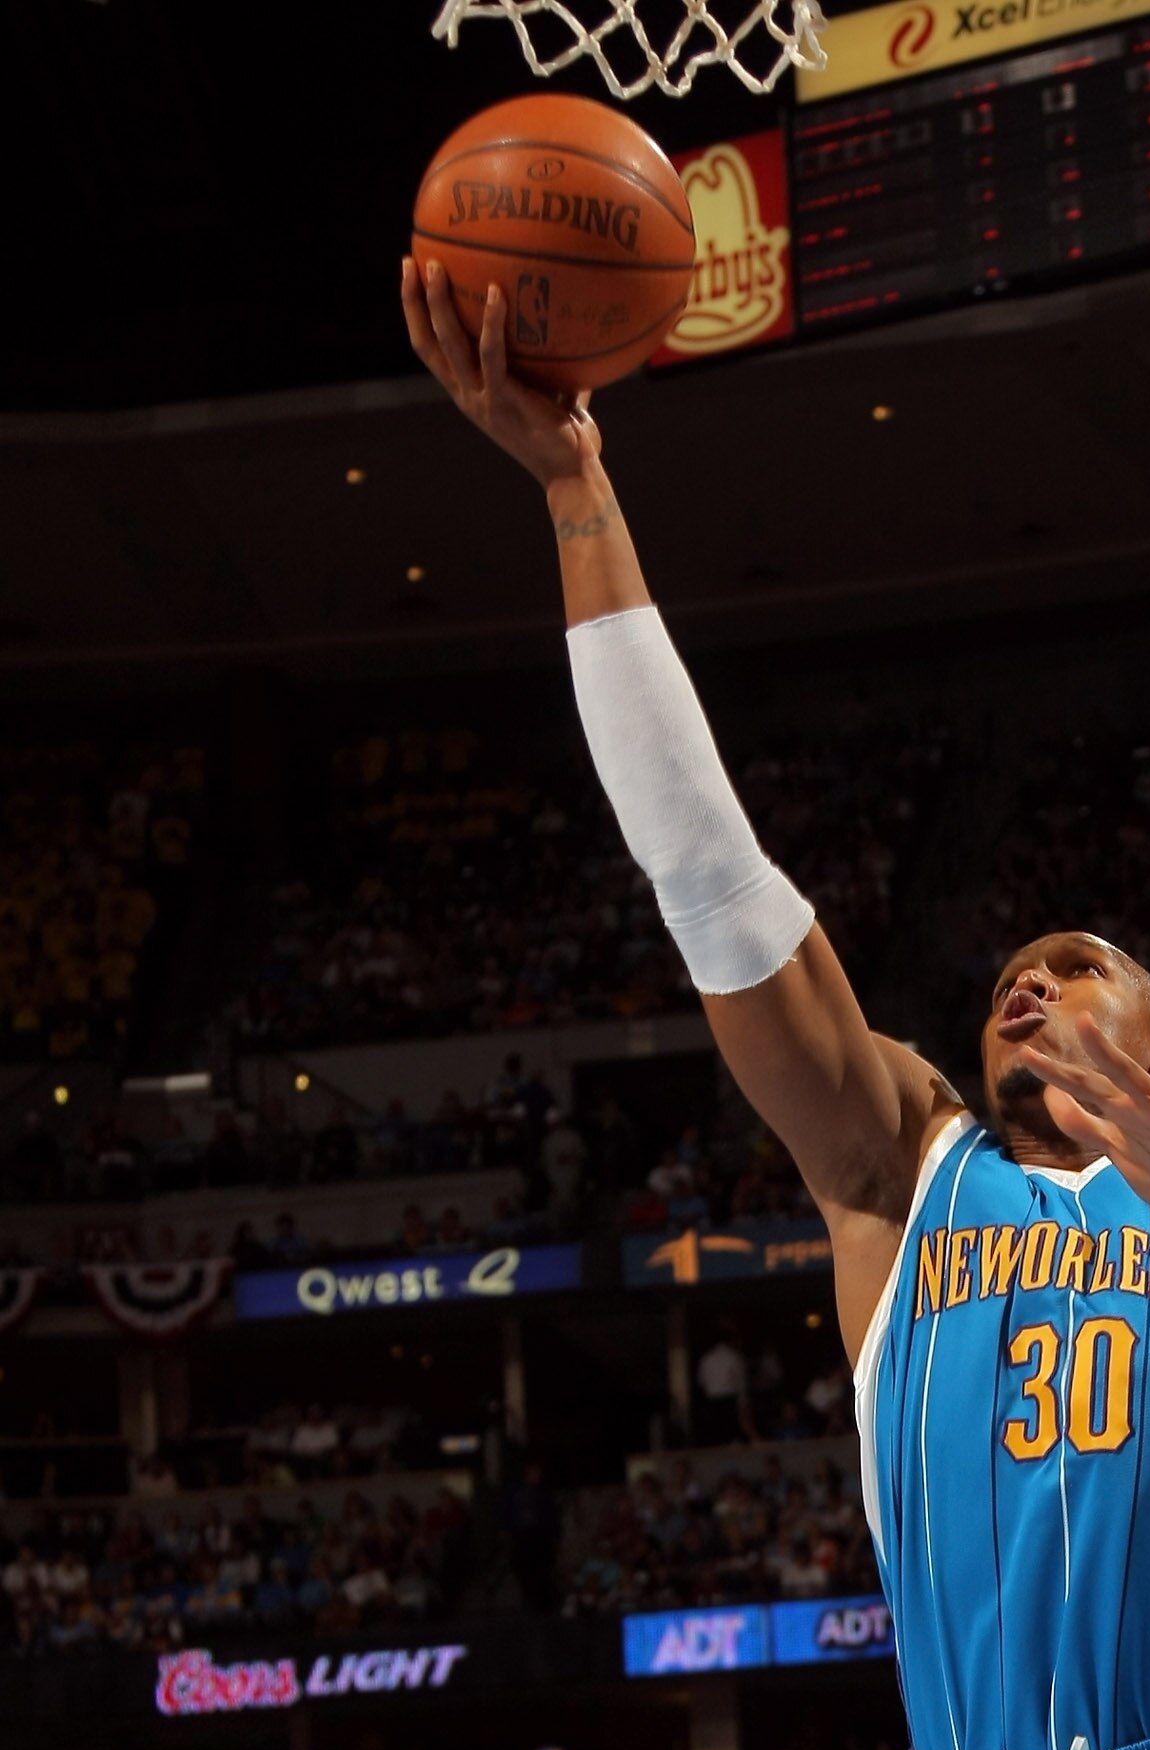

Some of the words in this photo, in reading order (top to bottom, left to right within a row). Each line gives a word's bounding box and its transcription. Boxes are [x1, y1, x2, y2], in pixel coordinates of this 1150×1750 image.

[953, 0, 1029, 40] Xcel
[448, 179, 641, 252] SPALDING
[692, 234, 776, 310] rby's
[297, 1267, 444, 1315] Qwest
[1000, 1315, 1140, 1464] 30
[652, 1613, 743, 1673] ADT
[817, 1605, 888, 1645] ADT
[156, 1649, 301, 1715] Coors
[305, 1645, 466, 1696] LIGHT
